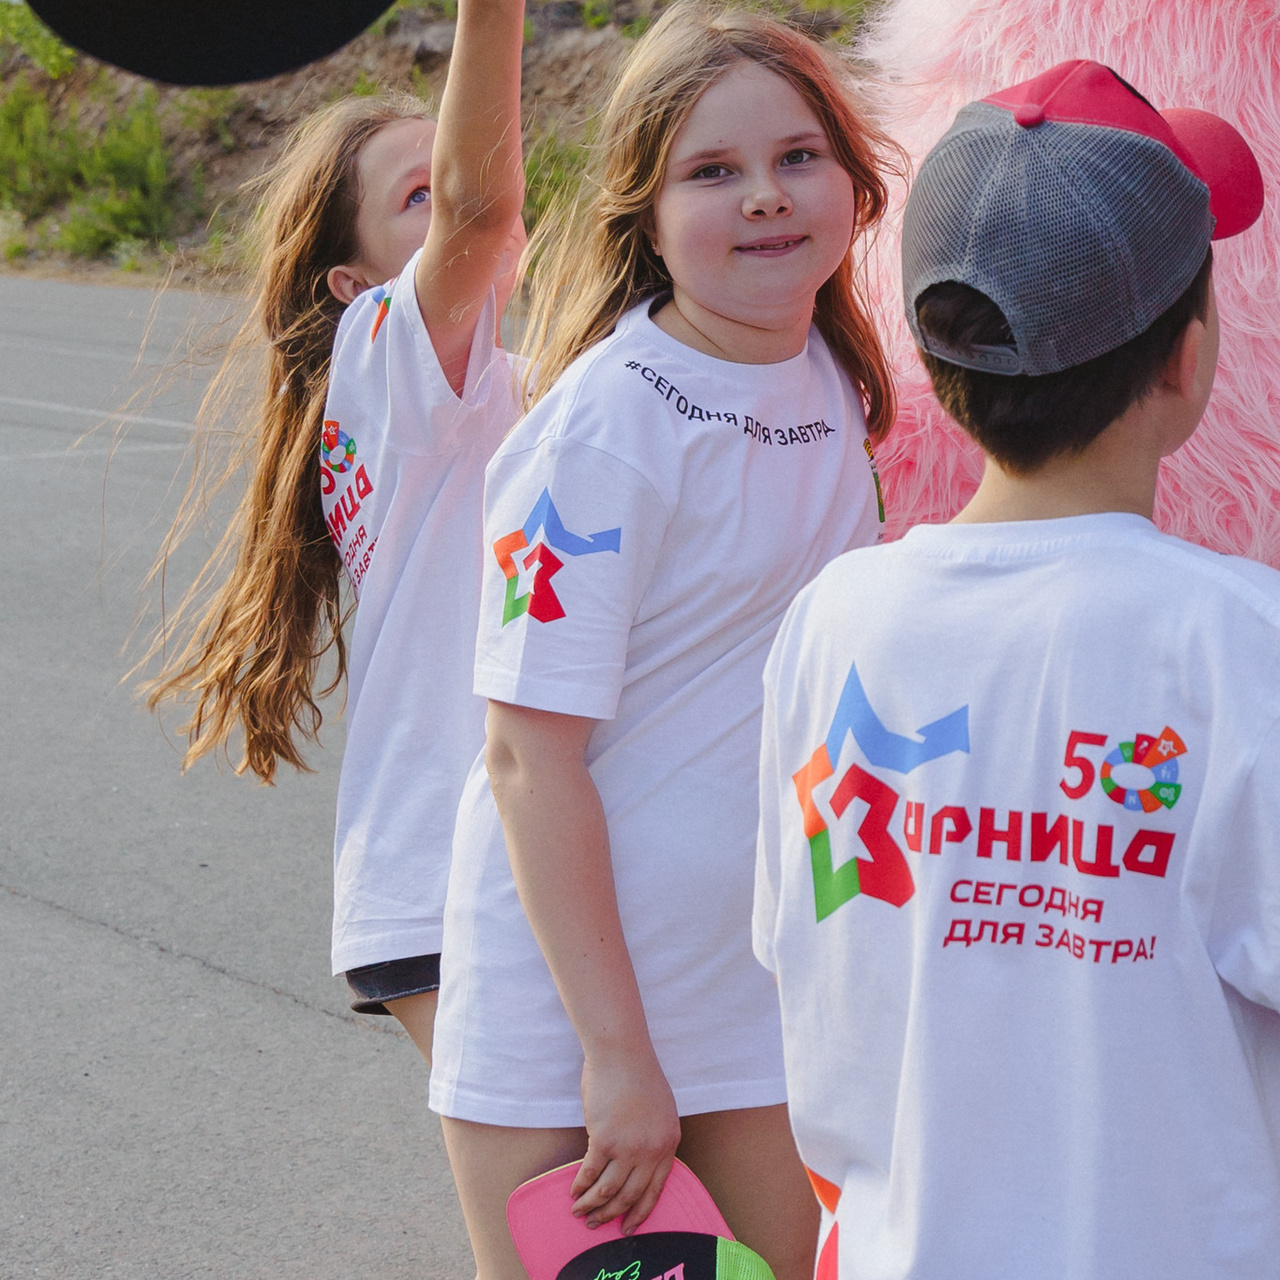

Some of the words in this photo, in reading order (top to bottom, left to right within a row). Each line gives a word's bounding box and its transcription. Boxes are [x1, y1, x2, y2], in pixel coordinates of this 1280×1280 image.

[624, 360, 738, 427] #СЕГОДНЯ
[743, 415, 773, 446] ДЛЯ
[774, 419, 836, 446] ЗАВТРА
[949, 879, 1104, 923] СЕГОДНЯ
[942, 919, 1025, 948] ДЛЯ
[1035, 923, 1156, 964] ЗАВТРА!
